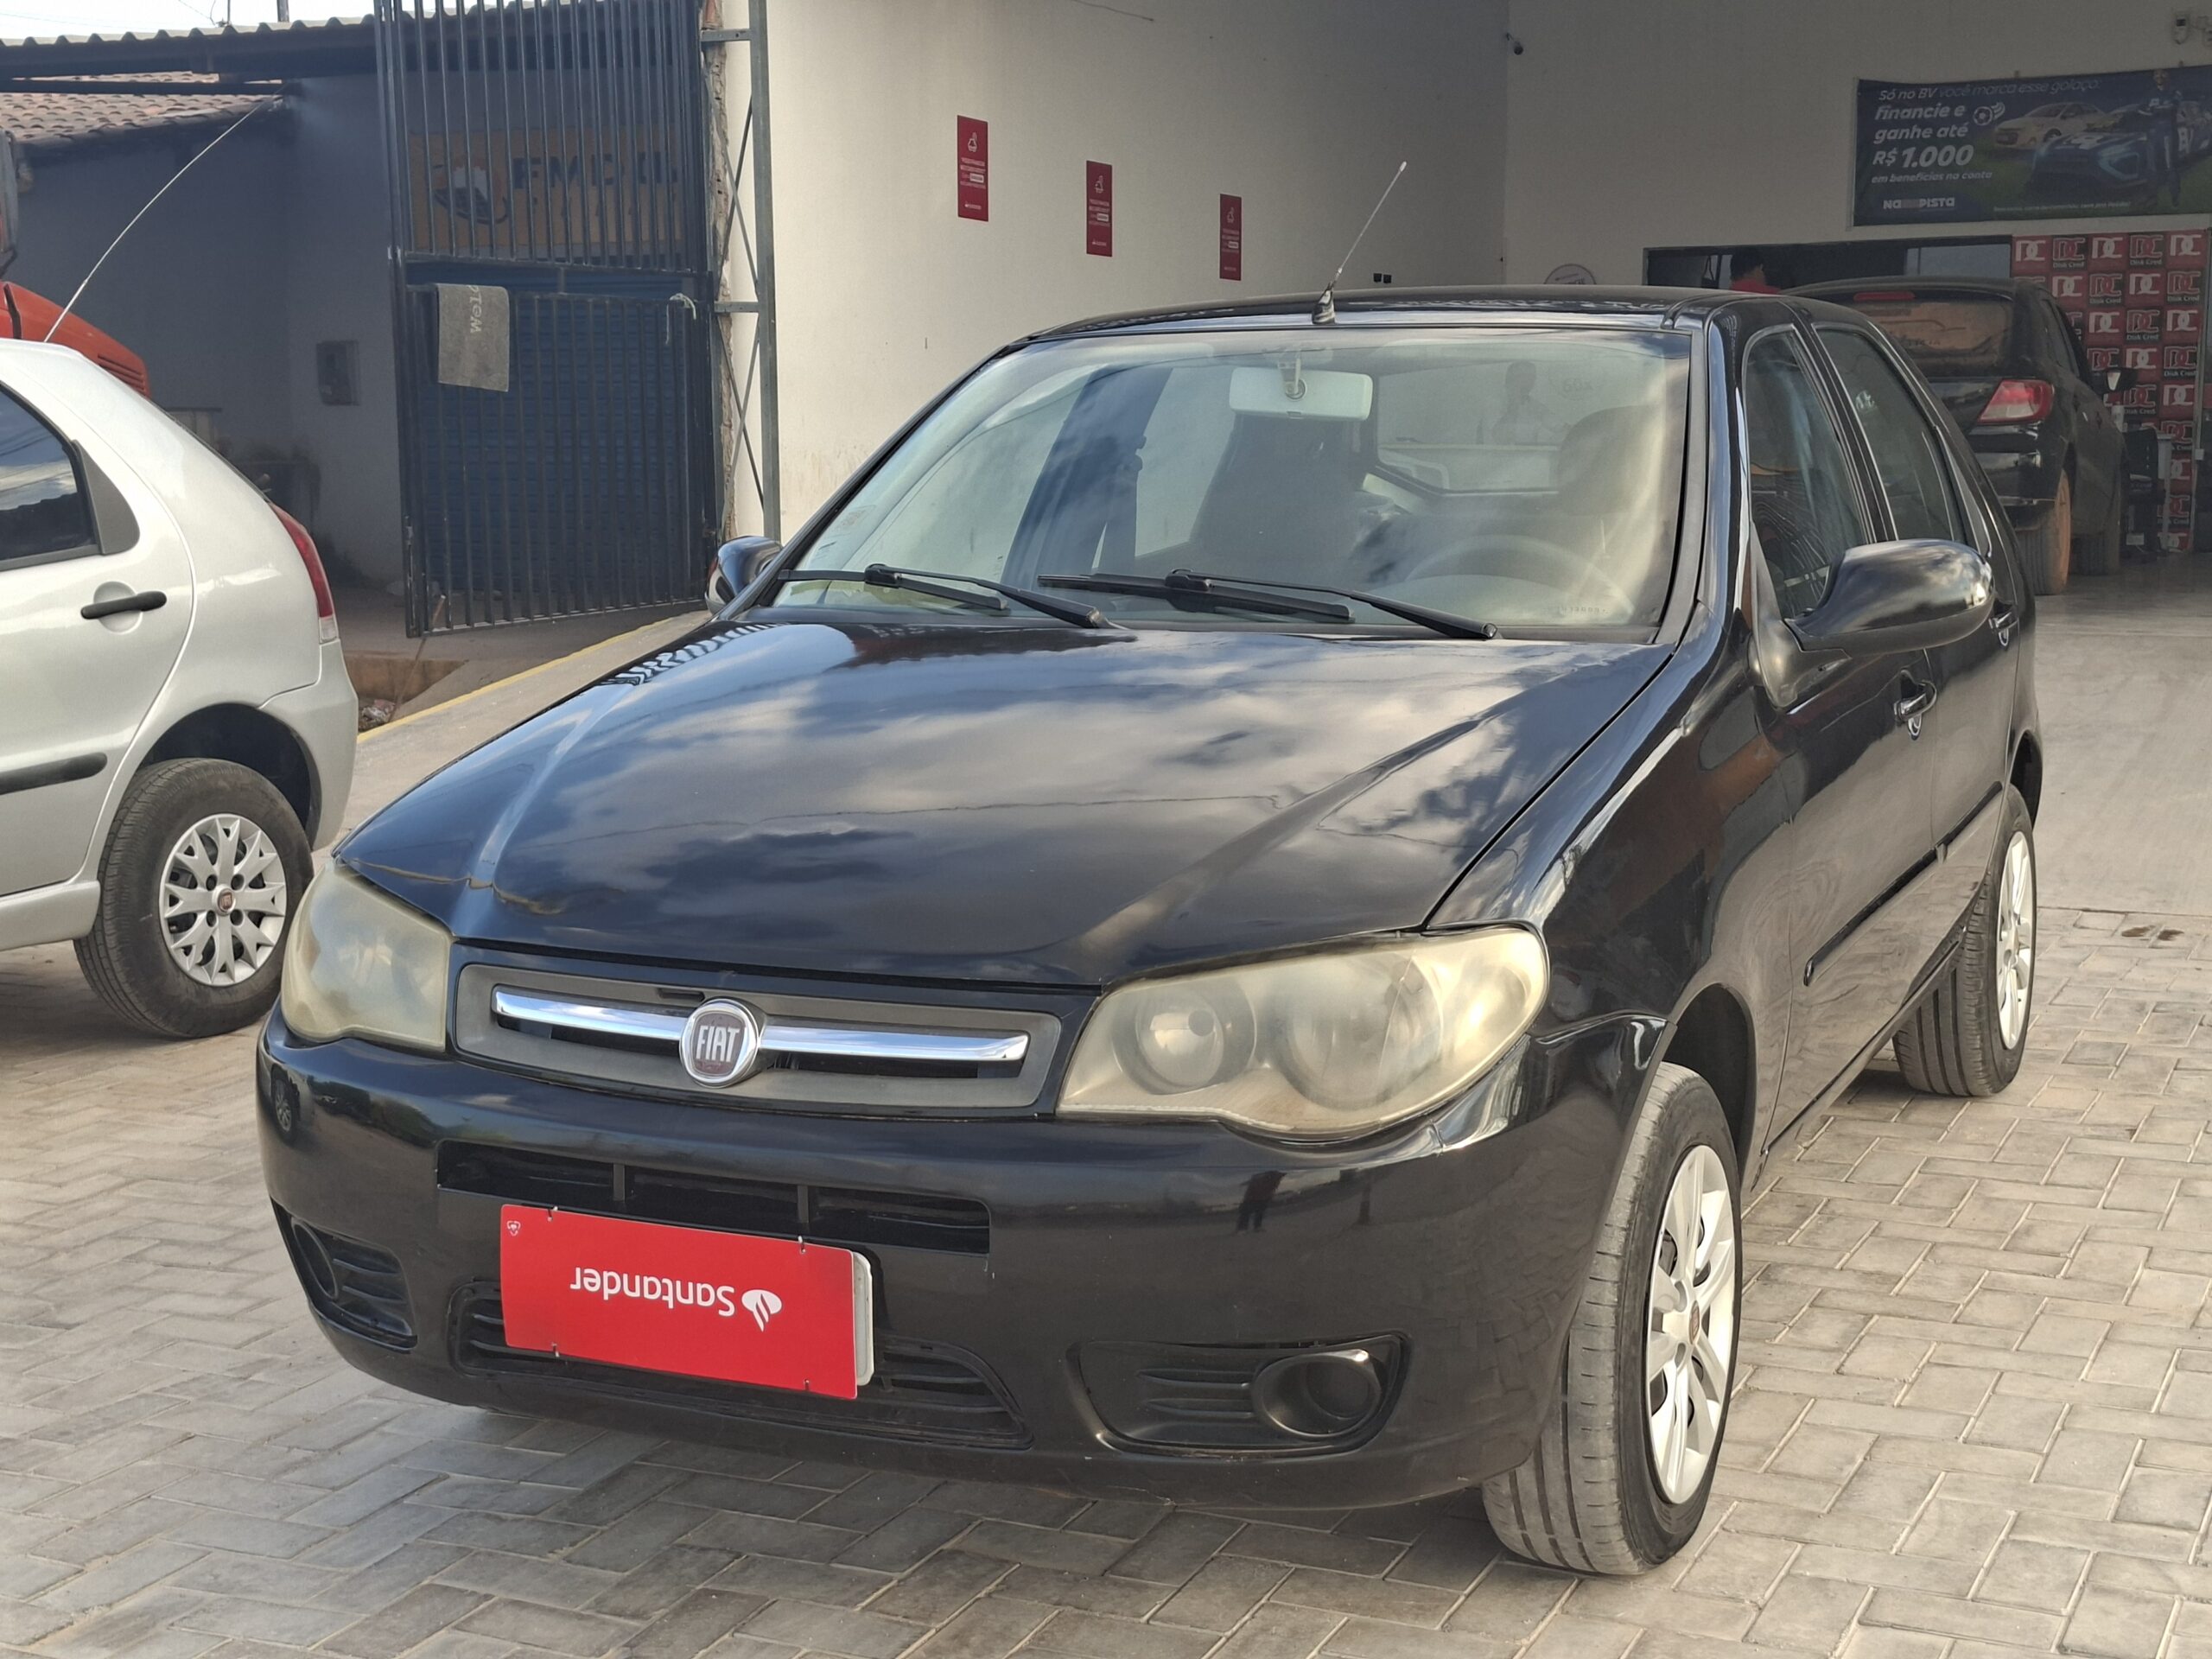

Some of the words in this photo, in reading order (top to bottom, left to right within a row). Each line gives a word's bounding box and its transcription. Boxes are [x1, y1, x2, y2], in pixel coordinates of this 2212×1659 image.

[1878, 89, 1897, 100] Só
[1897, 90, 1916, 99] no
[1917, 87, 1937, 99] BV
[1971, 85, 2017, 96] marca
[1874, 102, 1950, 120] financie
[1954, 105, 1966, 118] e
[1873, 124, 1933, 144] ganhe
[1936, 122, 1969, 138] até
[1872, 147, 1898, 167] R$
[1901, 144, 1974, 168] 1.000
[695, 1024, 741, 1064] FIAT
[569, 1266, 736, 1317] Santander
